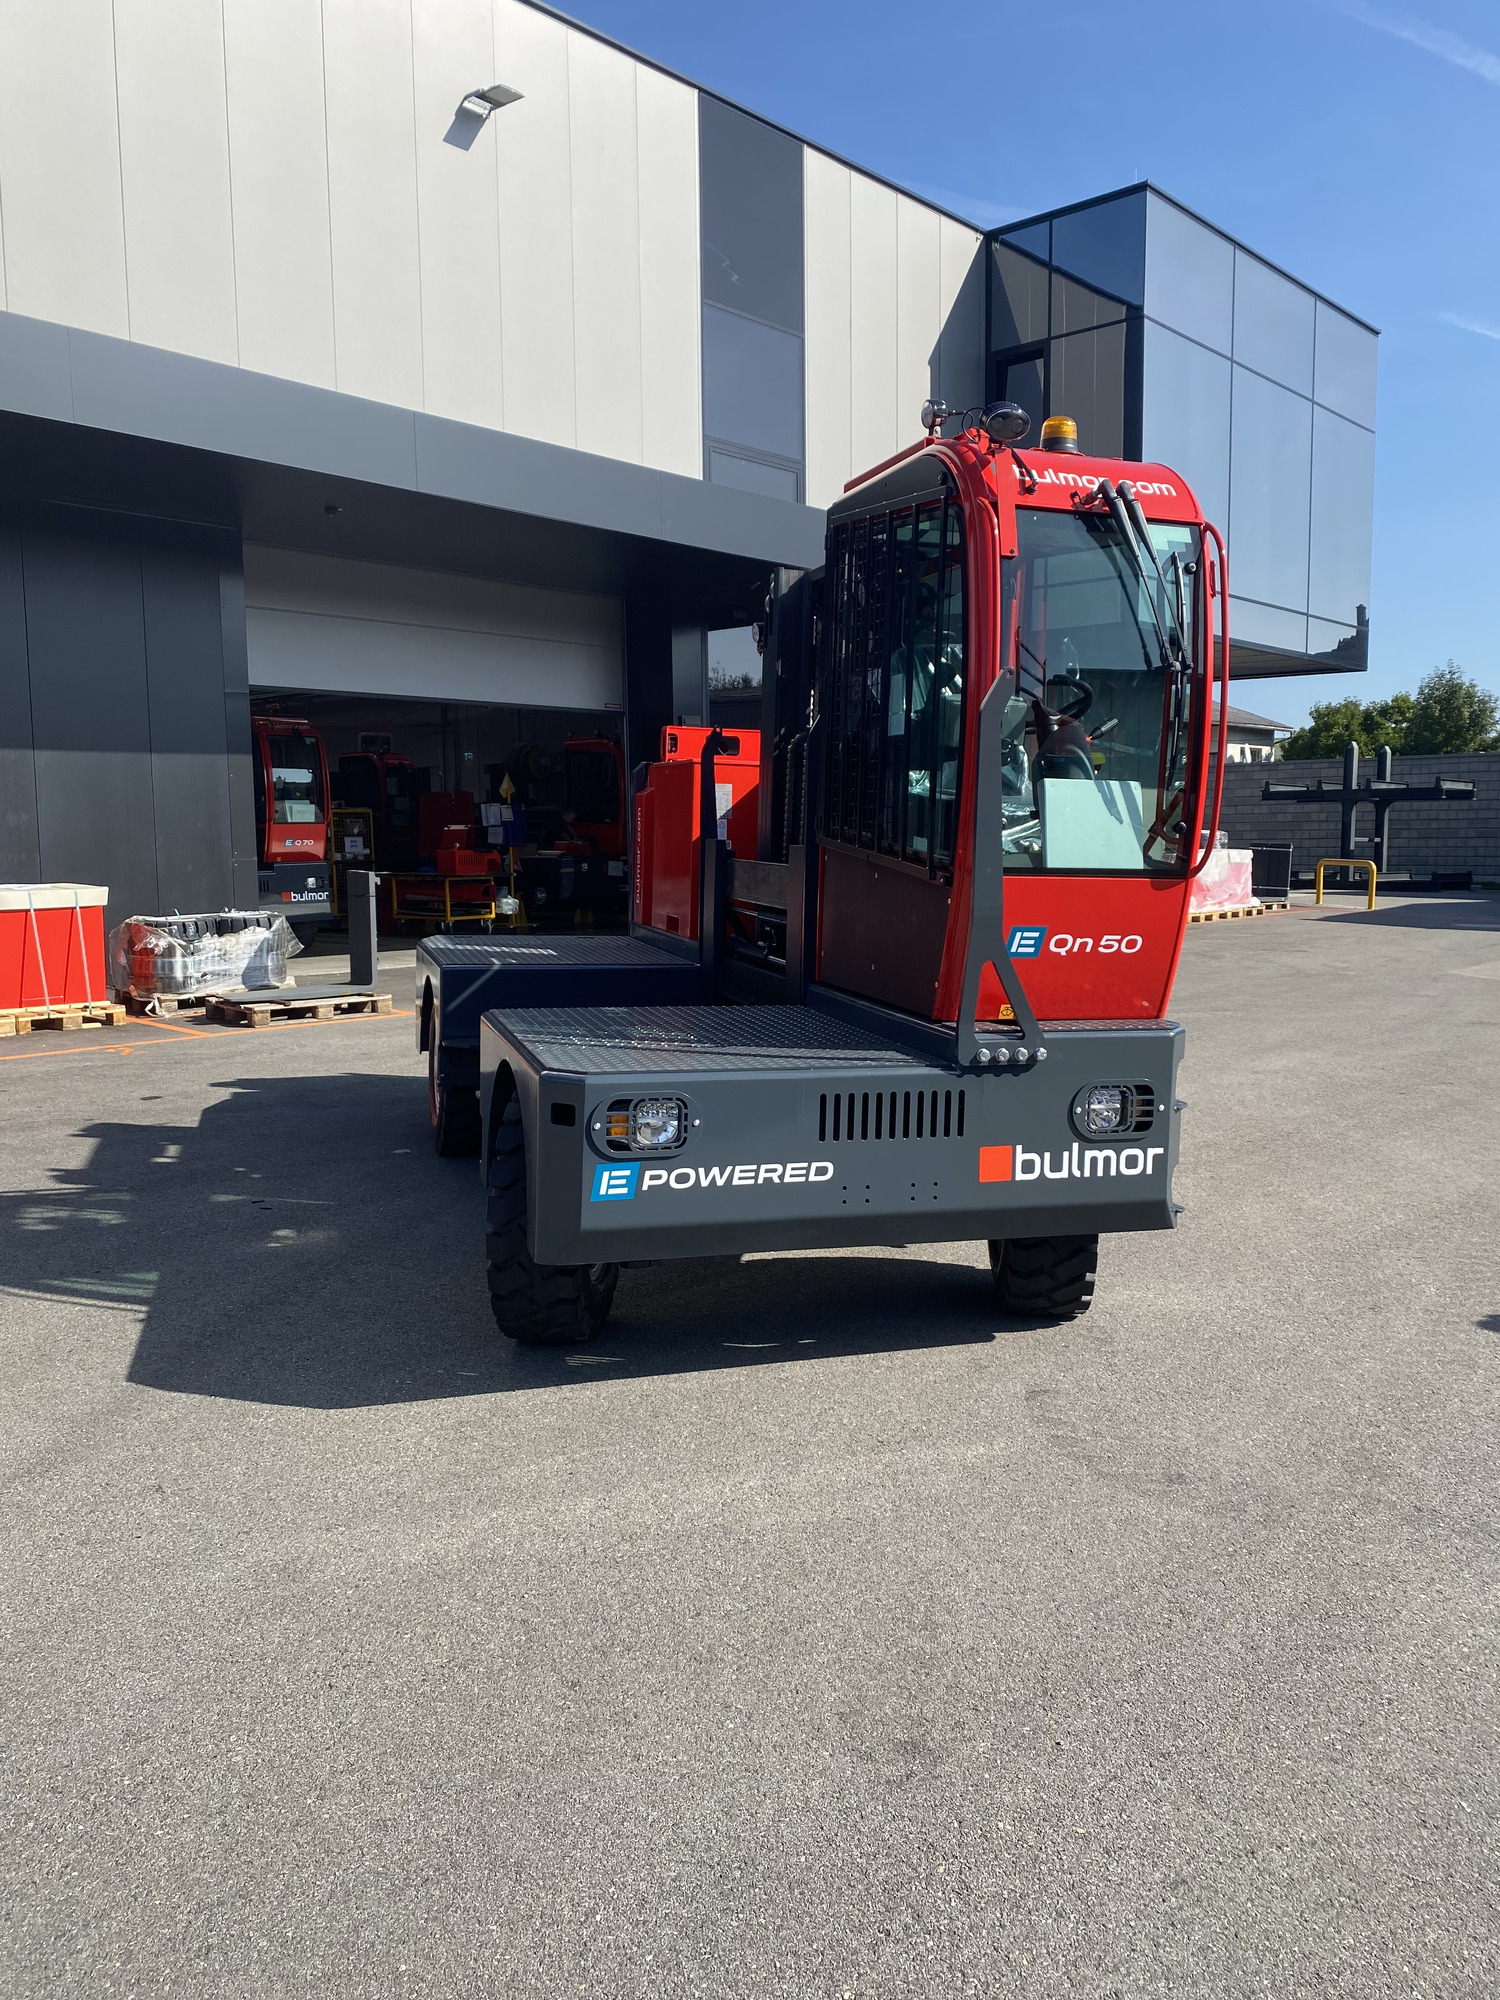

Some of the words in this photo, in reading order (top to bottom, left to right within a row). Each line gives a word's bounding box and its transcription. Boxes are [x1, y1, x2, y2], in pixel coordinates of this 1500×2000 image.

[291, 891, 329, 902] bulmor
[1049, 934, 1094, 956] Qn
[1097, 935, 1143, 954] 50
[1015, 1142, 1164, 1181] bulmor
[642, 1161, 834, 1191] POWERED
